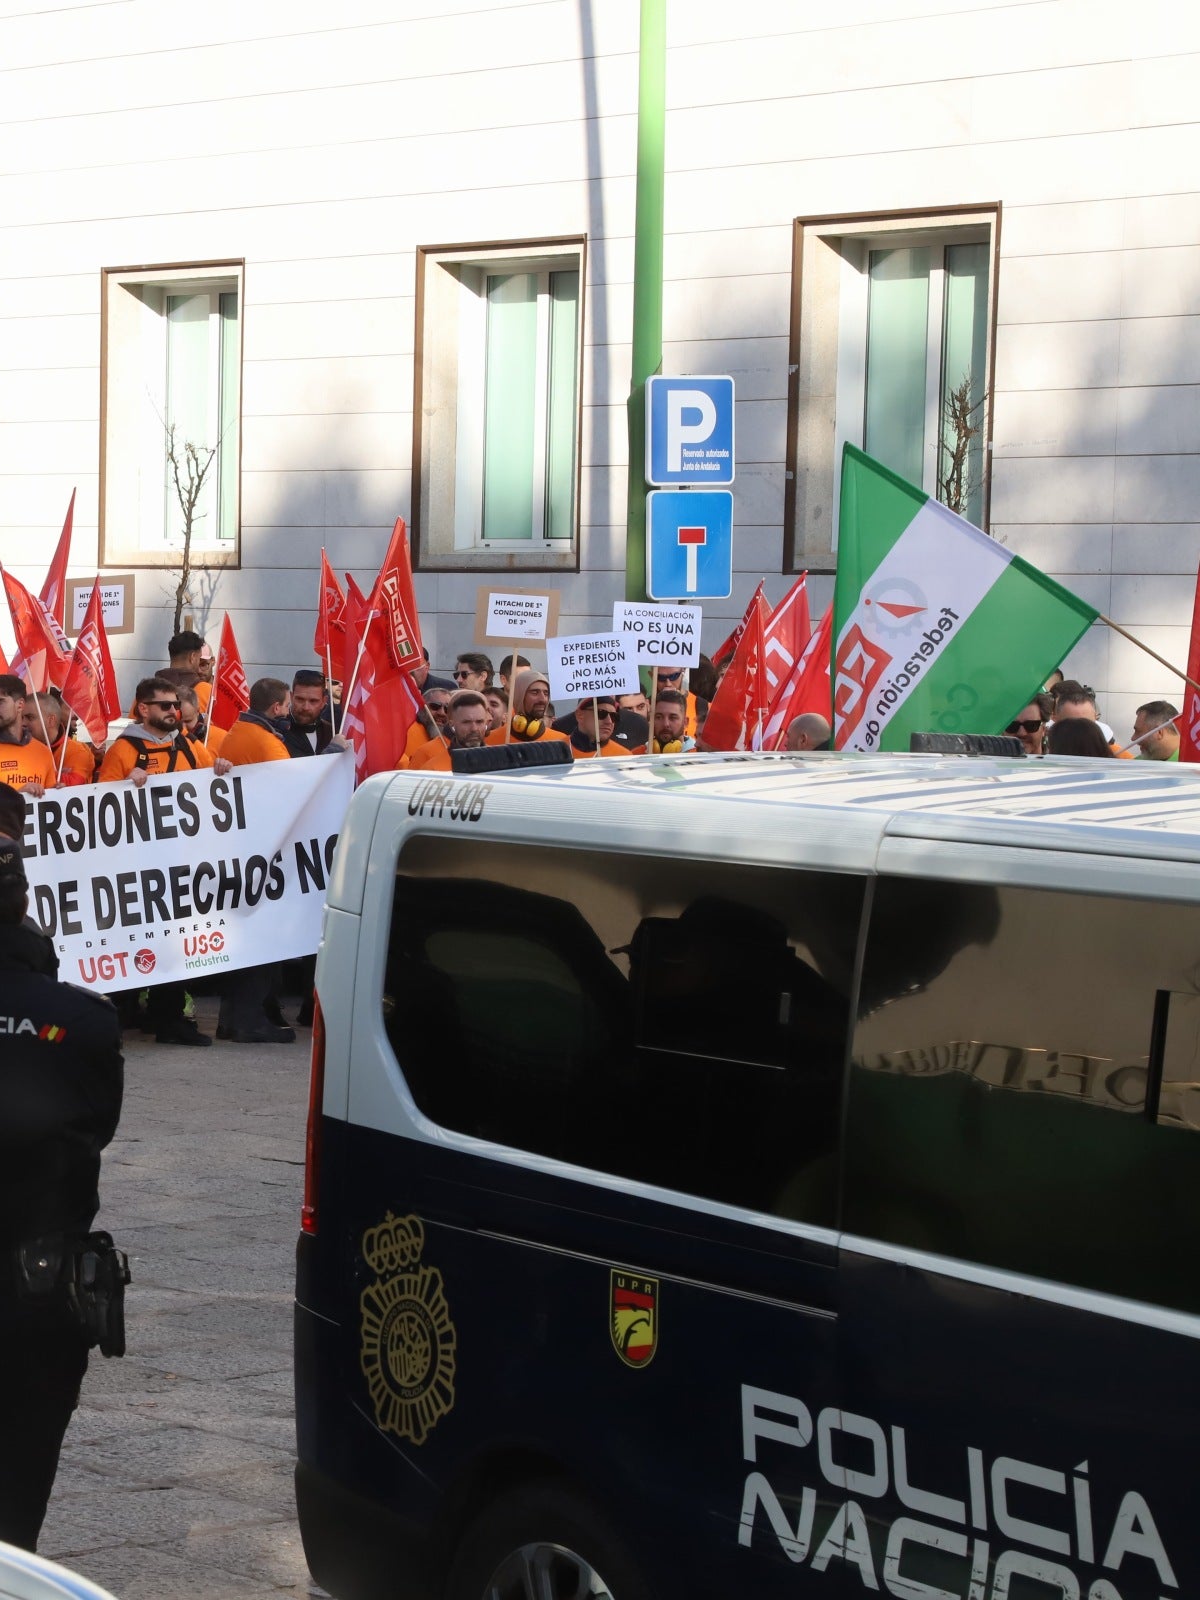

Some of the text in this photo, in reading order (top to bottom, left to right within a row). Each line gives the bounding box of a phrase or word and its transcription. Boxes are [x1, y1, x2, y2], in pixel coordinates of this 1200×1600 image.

[667, 390, 717, 472] P
[495, 600, 523, 608] HITACHI
[493, 609, 543, 618] CONDICIONES
[635, 609, 694, 620] CONCILIACIÓN
[623, 620, 694, 635] NO ES UNA
[563, 639, 621, 652] EXPEDIENTES
[637, 637, 693, 656] PCIÓN
[561, 650, 626, 666] DE PRESIÓN
[594, 664, 617, 676] MÁS
[565, 677, 626, 692] OPRESIÓN!
[7, 774, 42, 784] Hitachi
[408, 779, 494, 822] UPR-90B
[21, 776, 246, 859] ERSIONES SI
[34, 879, 83, 938] DE
[91, 849, 285, 931] DERECHOS
[86, 938, 107, 948] DE
[129, 918, 226, 942] EMPRESA
[184, 931, 225, 957] USO
[78, 951, 129, 984] UGT
[185, 953, 230, 970] industria
[618, 1277, 652, 1294] UPR
[741, 1384, 1179, 1588] POLICÍA
[738, 1472, 1173, 1600] NACIO
